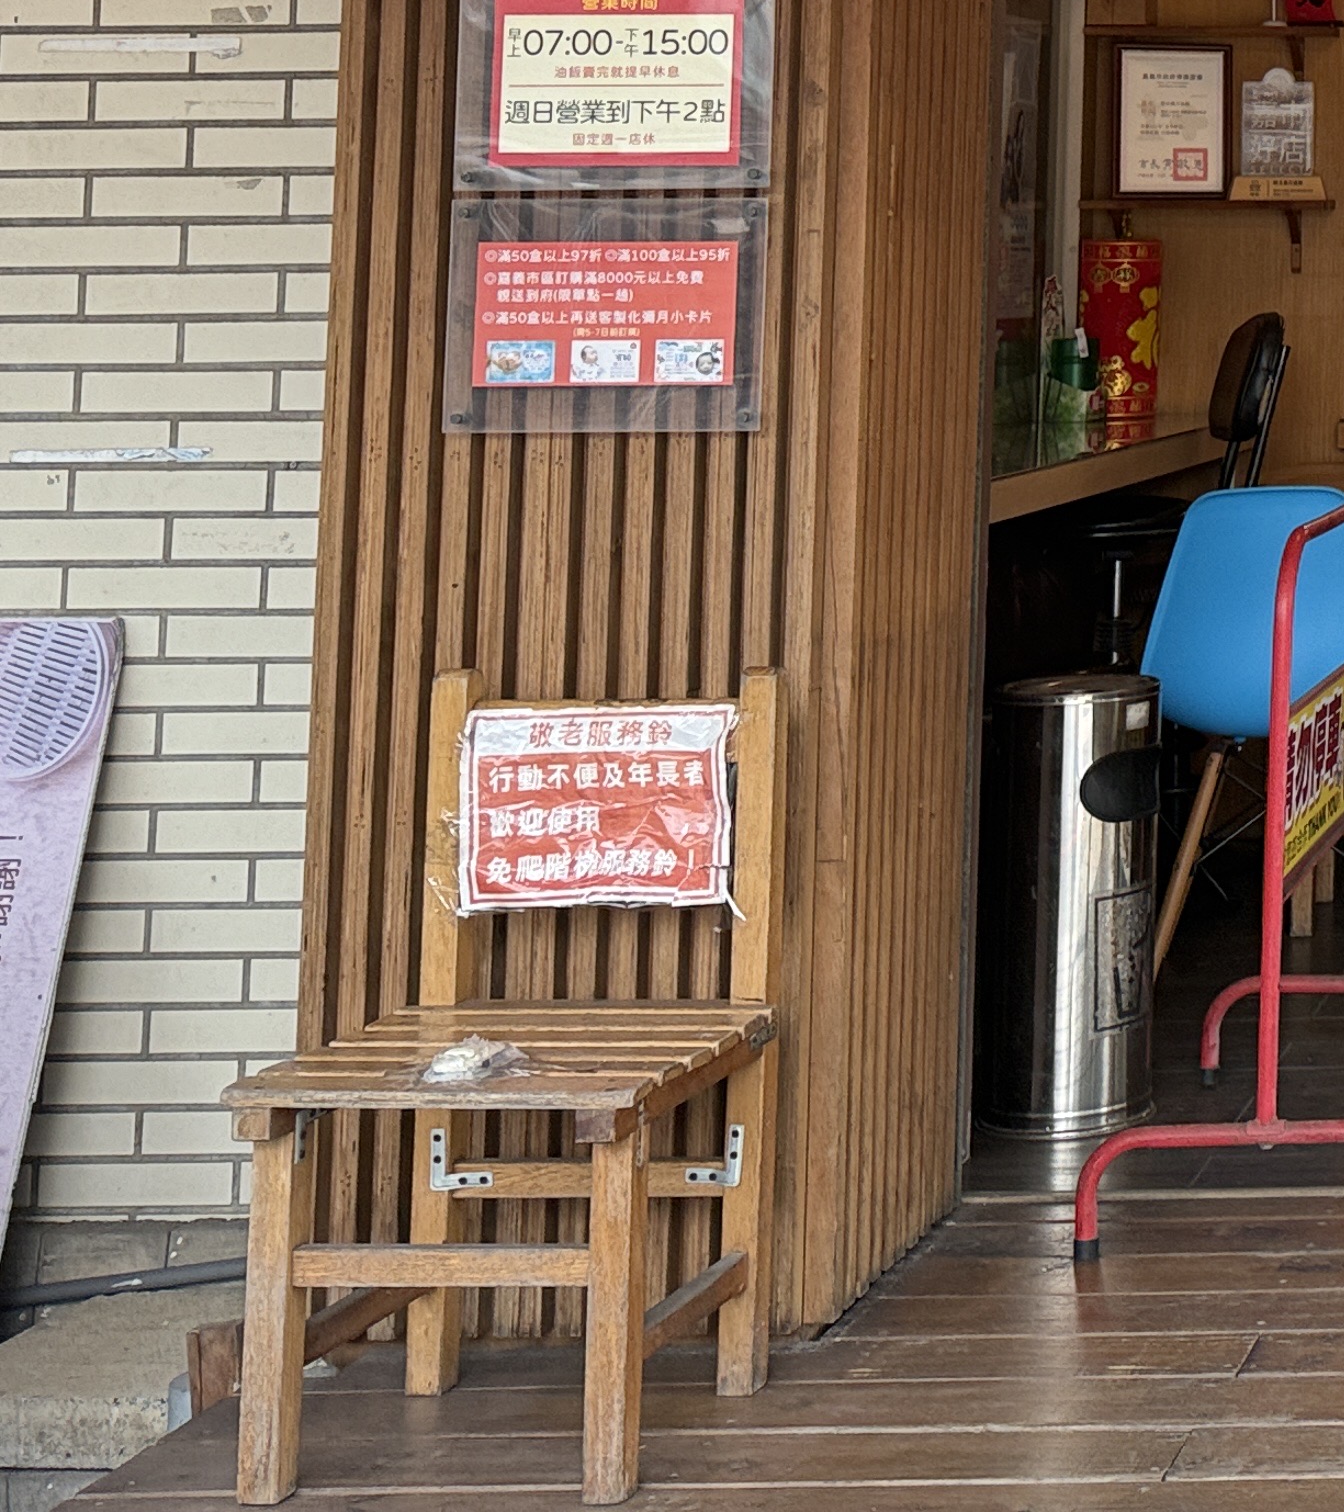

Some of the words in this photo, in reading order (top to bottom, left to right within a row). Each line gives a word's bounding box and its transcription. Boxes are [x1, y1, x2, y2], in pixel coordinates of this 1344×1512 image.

[643, 29, 728, 55] 15:00
[555, 65, 680, 79] 油飯賣完就提早休息
[505, 99, 725, 124] 週日營業到下午2點
[572, 133, 656, 146] 固定週一店休
[529, 718, 672, 748] 敬老服務鈴
[489, 760, 704, 793] 行動不便及年長者
[489, 808, 600, 837] 歡迎使用
